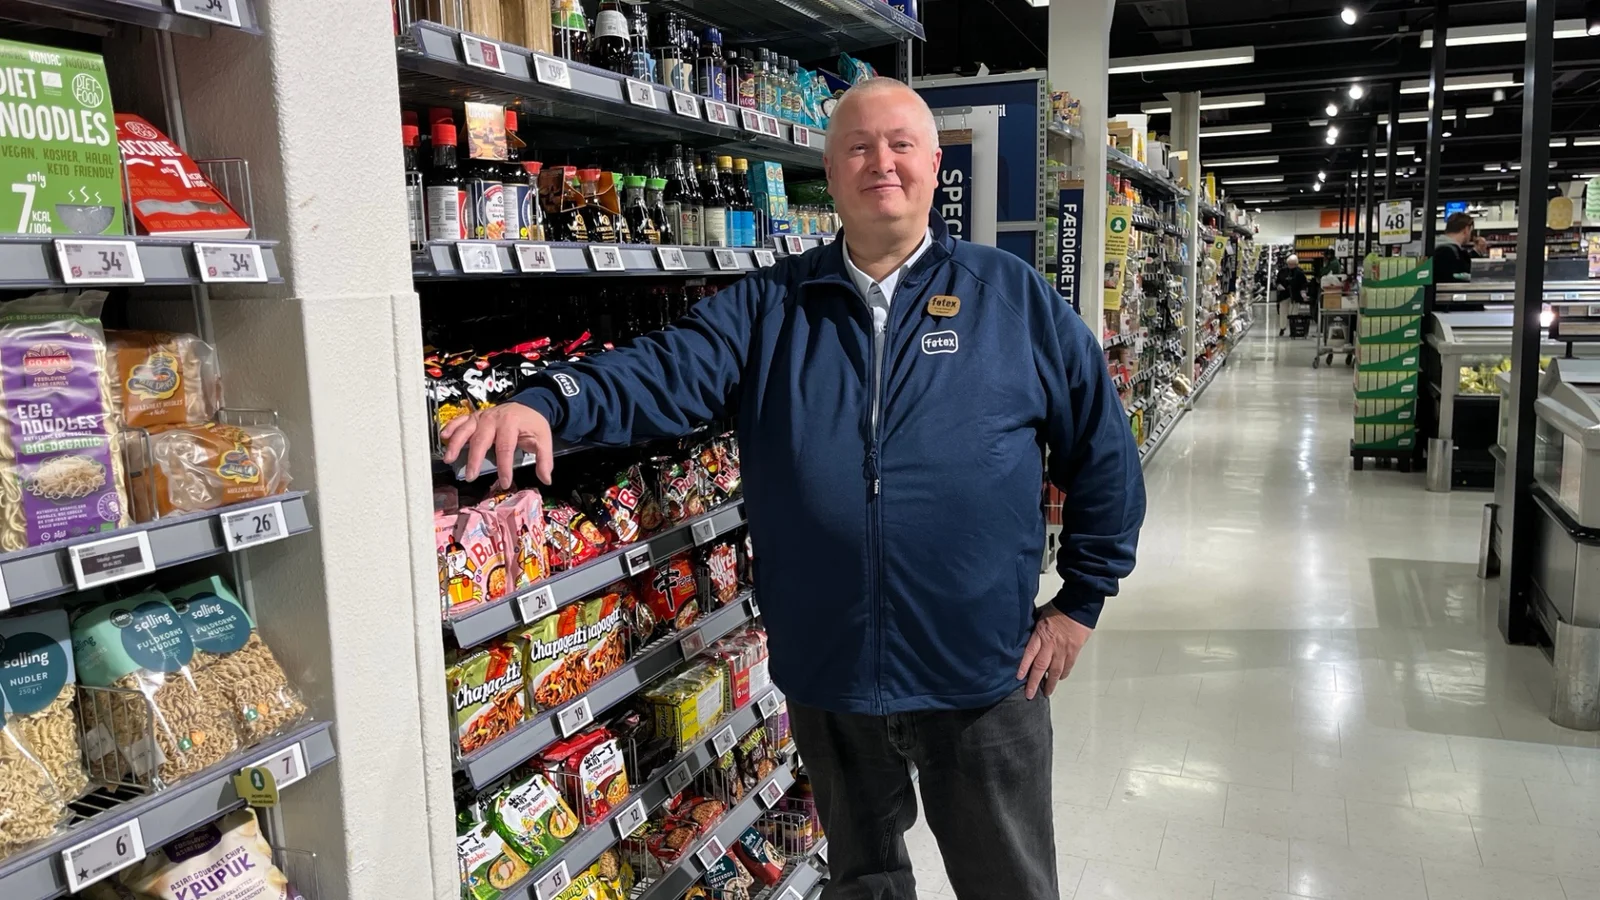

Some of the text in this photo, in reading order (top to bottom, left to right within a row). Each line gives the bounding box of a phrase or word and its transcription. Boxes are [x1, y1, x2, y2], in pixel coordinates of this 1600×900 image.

[28, 50, 62, 66] KONJAC
[76, 88, 100, 106] FOOD
[0, 101, 110, 147] NOODLES
[85, 152, 114, 166] HALAL
[26, 171, 47, 188] only
[47, 163, 114, 180] KETO FRIENDLY
[161, 159, 192, 188] 7
[11, 183, 36, 233] 7
[1385, 213, 1405, 230] 48
[97, 251, 122, 272] 34
[229, 253, 249, 272] 34
[463, 367, 513, 403] Soba
[17, 403, 53, 420] EGG
[21, 415, 98, 435] NOODLES
[26, 437, 101, 454] BIO-ORGANIC
[253, 513, 272, 534] 26
[191, 604, 224, 619] salling
[536, 596, 548, 609] 24
[134, 612, 173, 632] salling
[195, 615, 237, 635] FULDKORNS
[207, 623, 236, 637] NUDLER
[137, 628, 183, 651] FULDKORNS
[150, 637, 181, 654] NUDLER
[531, 627, 588, 662] Chapagetti
[4, 651, 49, 671] salling
[9, 672, 48, 687] NUDLER
[574, 709, 584, 721] 19
[282, 755, 292, 775] 7
[630, 809, 640, 822] 12
[116, 835, 127, 857] 6
[170, 845, 246, 891] ASIAN GOURMET CHIPS
[175, 853, 256, 900] KRUPUK
